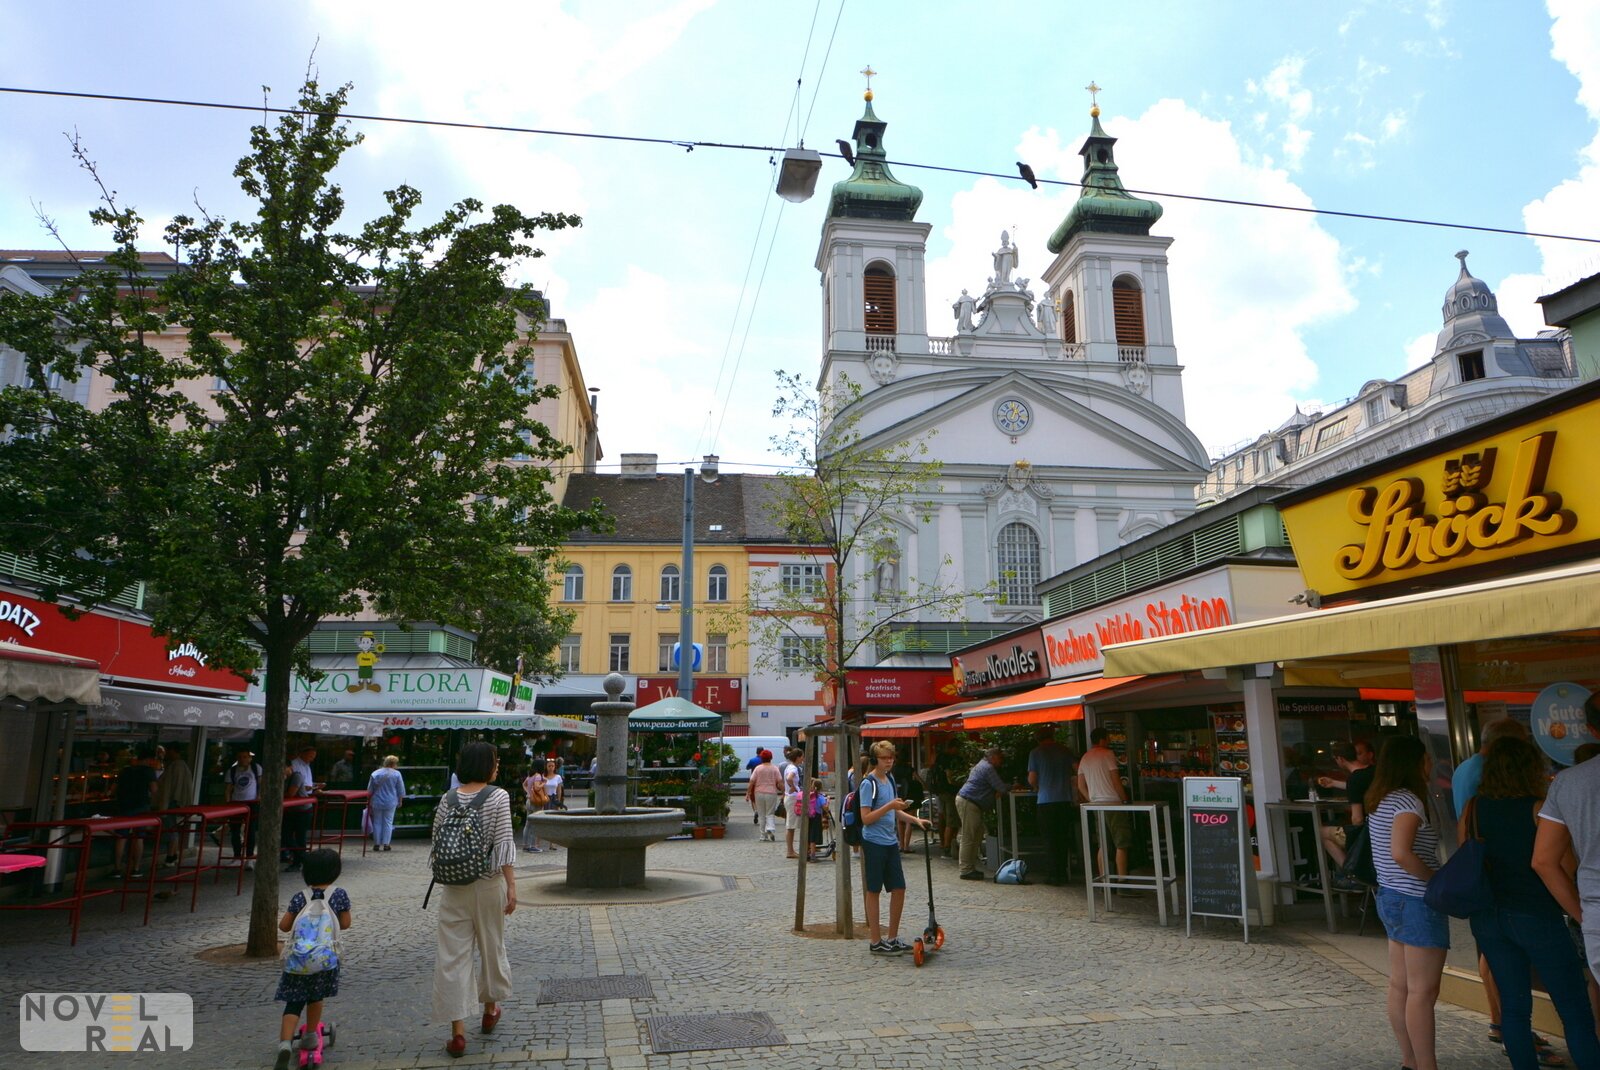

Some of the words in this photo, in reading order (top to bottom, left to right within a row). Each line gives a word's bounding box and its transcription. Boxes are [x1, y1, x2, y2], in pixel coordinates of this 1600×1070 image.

[1334, 435, 1563, 580] Ströck
[1046, 628, 1099, 667] Rochus
[1096, 612, 1144, 646] Wilde
[1146, 594, 1233, 638] Station
[986, 646, 1036, 680] Noodles
[387, 673, 473, 693] FLORA
[390, 697, 467, 705] www.penzo-flora.at
[1291, 702, 1325, 713] Speisen
[1327, 703, 1347, 712] auch
[1548, 703, 1586, 721] Gute
[429, 717, 523, 728] www.penzo-flora.at
[628, 720, 709, 730] www.penzo-flora.at
[1192, 795, 1233, 803] Heineken
